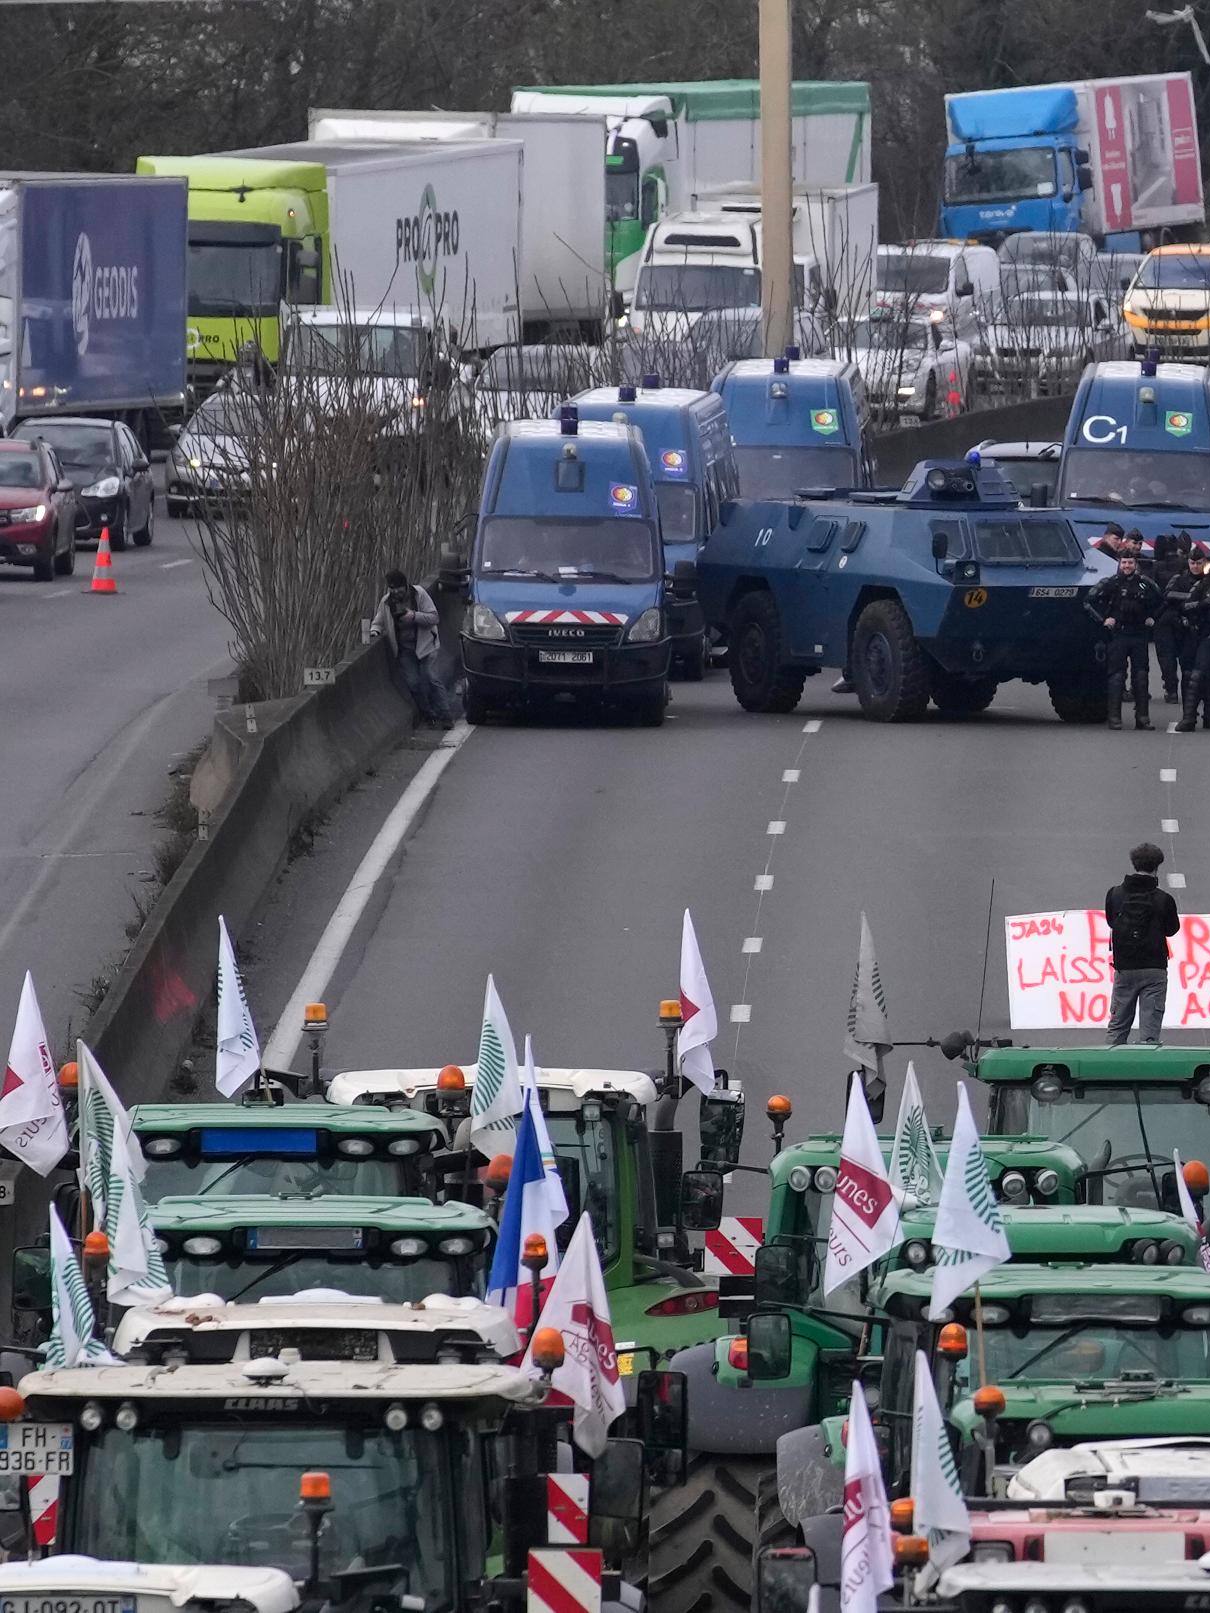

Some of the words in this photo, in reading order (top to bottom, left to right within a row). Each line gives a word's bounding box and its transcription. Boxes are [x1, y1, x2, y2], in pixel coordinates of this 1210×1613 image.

[397, 216, 420, 262] PRO
[435, 209, 459, 256] PRO
[94, 265, 139, 319] GEODIS
[1082, 415, 1128, 445] C1
[755, 528, 773, 547] 10
[548, 629, 585, 637] IVECO
[308, 671, 330, 681] 13.7
[1058, 991, 1114, 1024] NO
[224, 1398, 299, 1411] CLAAS
